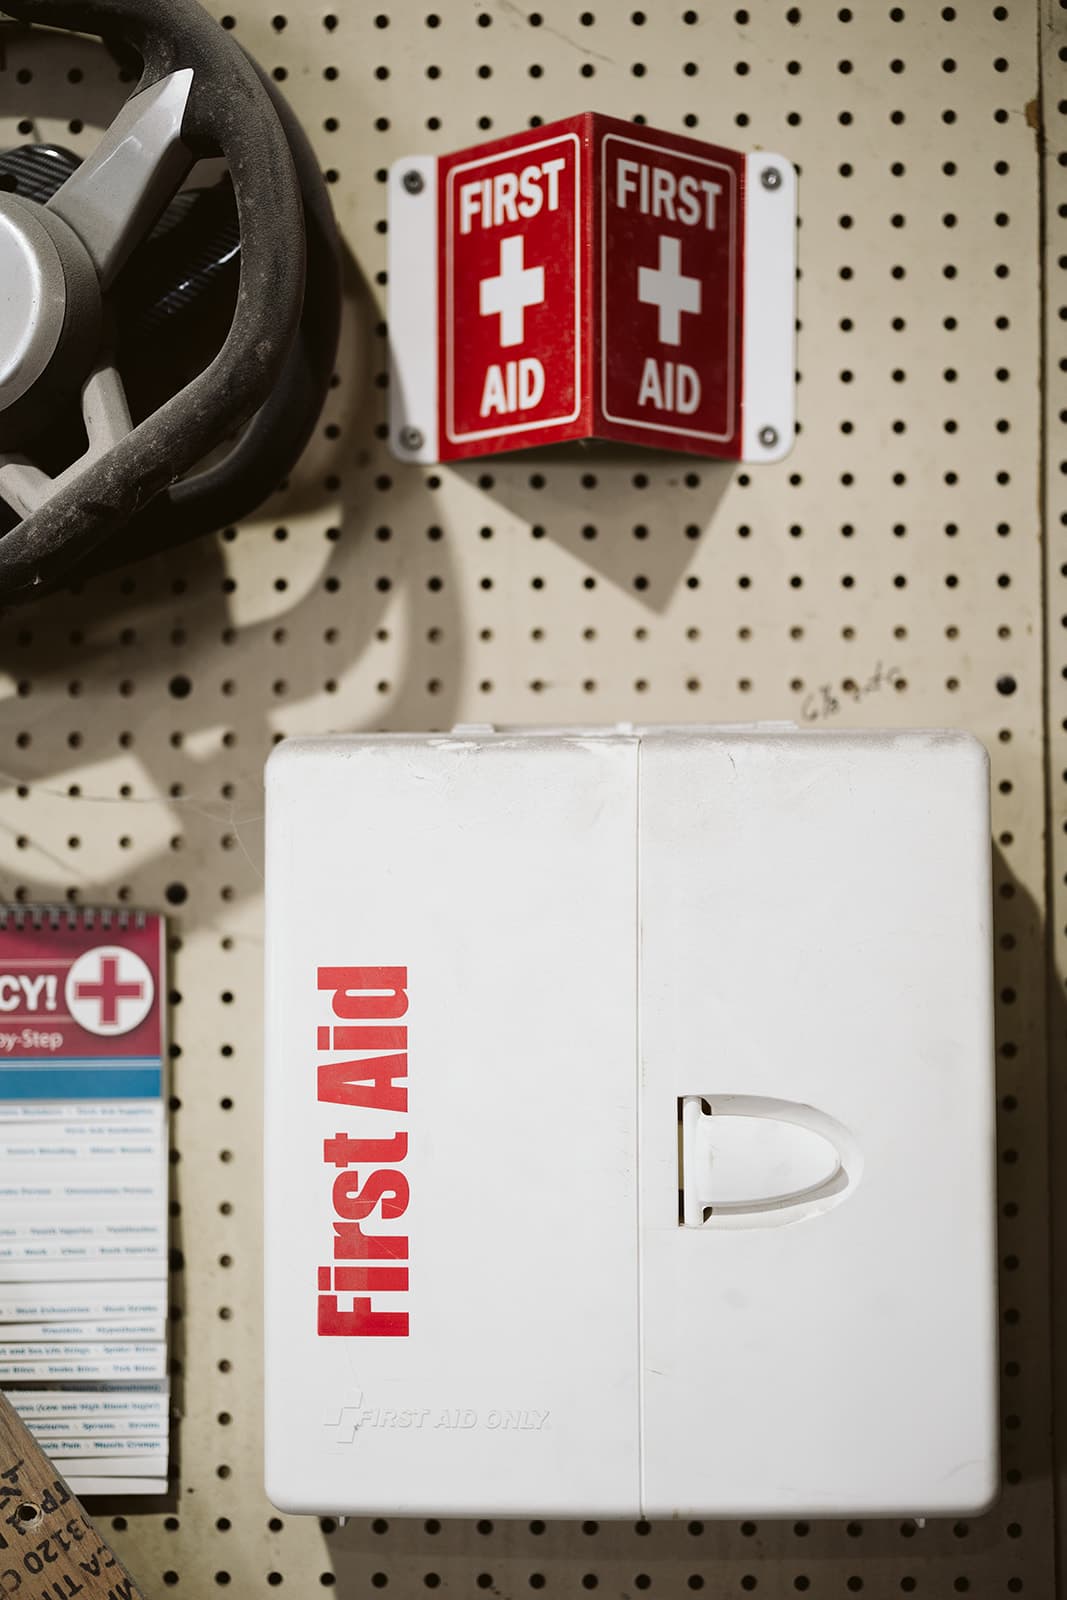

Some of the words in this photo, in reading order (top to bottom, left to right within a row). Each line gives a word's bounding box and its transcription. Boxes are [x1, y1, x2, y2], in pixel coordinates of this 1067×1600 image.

[460, 158, 566, 235] FIRST
[617, 158, 722, 232] FIRST
[479, 358, 546, 418] AID
[637, 358, 701, 415] AID
[317, 966, 409, 1113] Aid
[317, 1131, 410, 1337] First
[359, 1407, 432, 1429] FIRST
[433, 1408, 478, 1430] AID
[485, 1409, 552, 1431] ONLY
[24, 1517, 92, 1574] 3120
